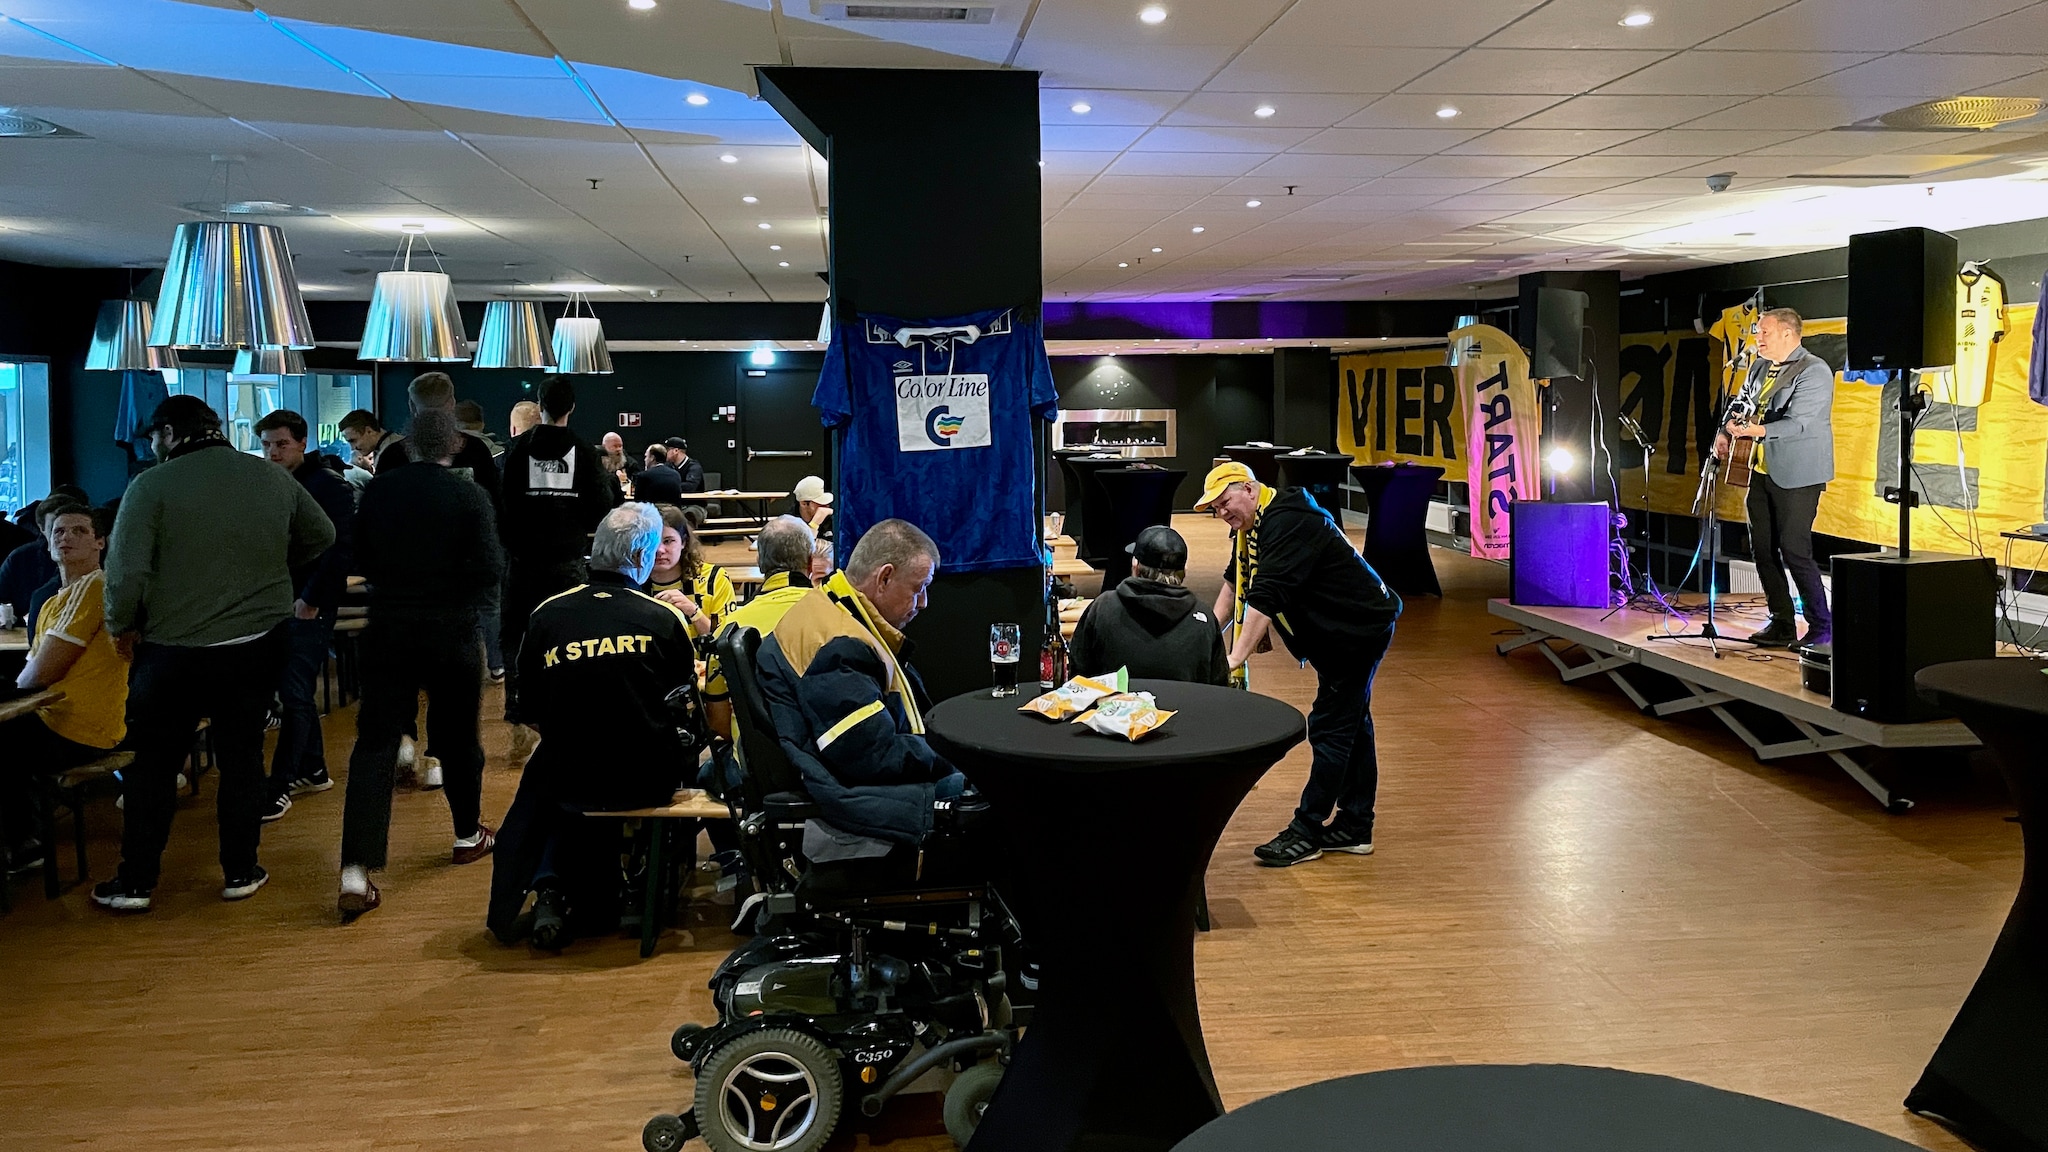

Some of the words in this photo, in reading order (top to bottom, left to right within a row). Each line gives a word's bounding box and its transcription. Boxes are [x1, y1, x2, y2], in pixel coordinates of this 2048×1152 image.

[897, 377, 947, 399] Color
[947, 377, 987, 398] Line
[565, 634, 653, 661] START
[854, 1049, 893, 1063] C350
